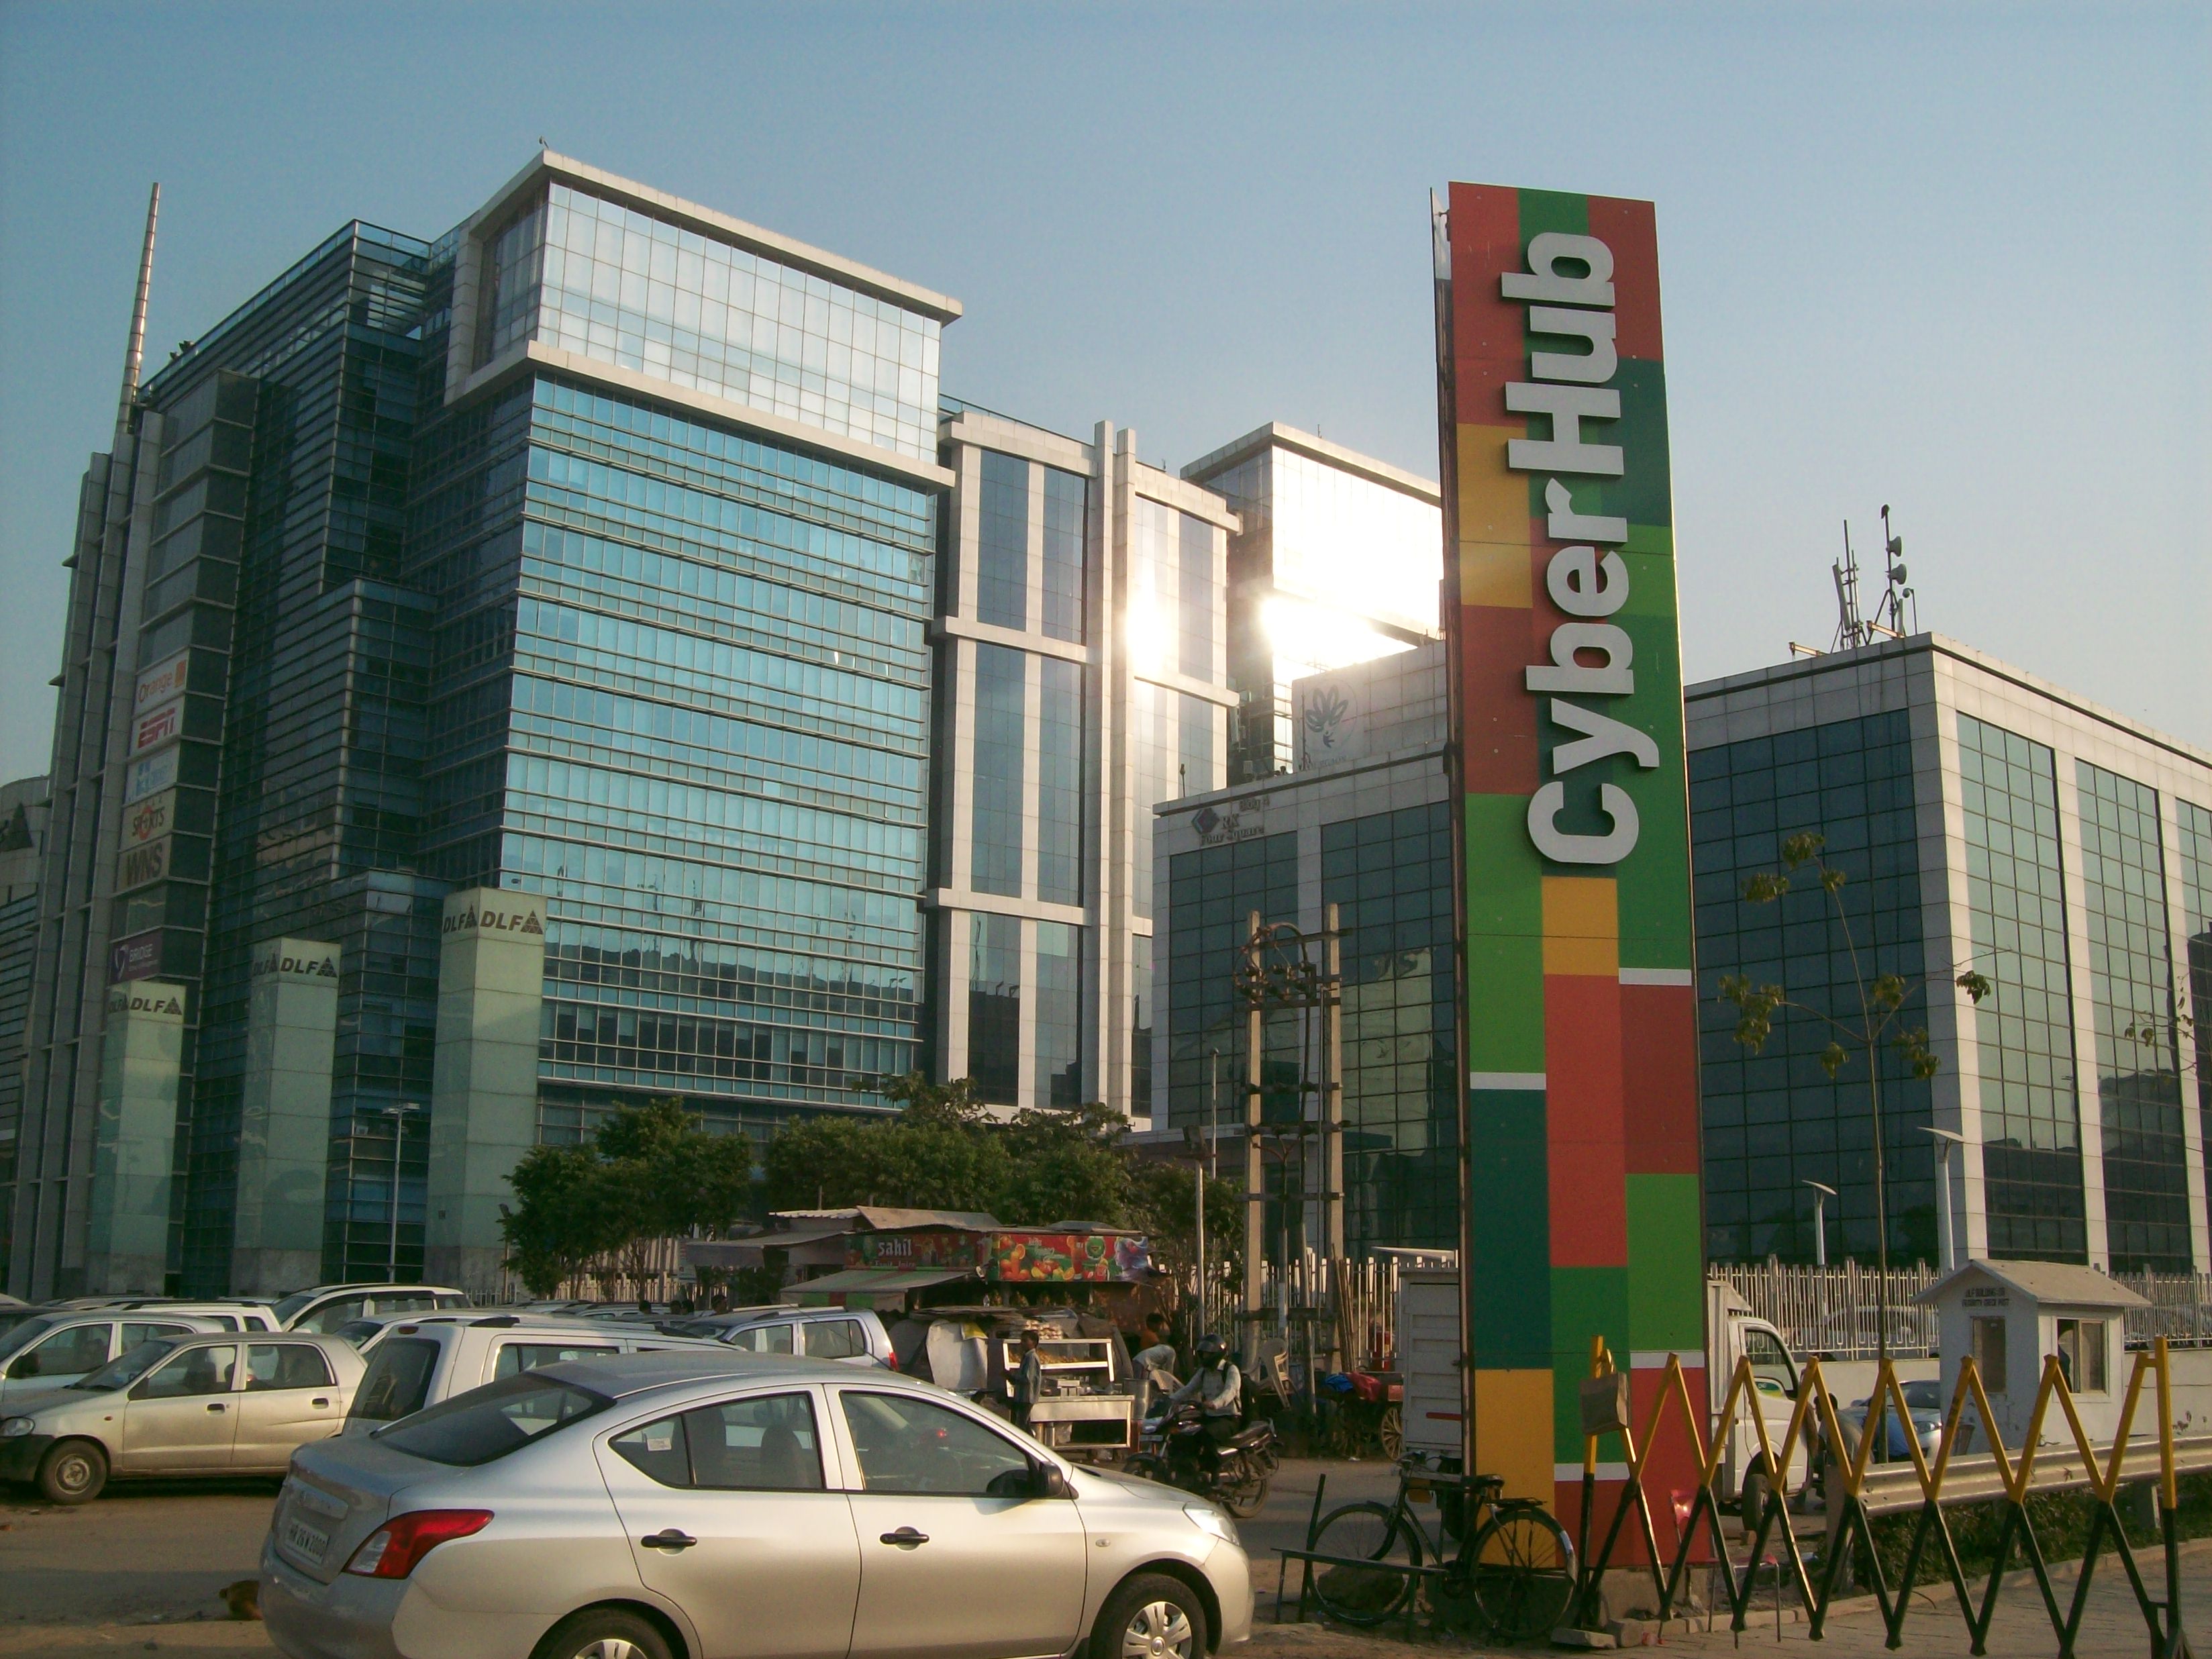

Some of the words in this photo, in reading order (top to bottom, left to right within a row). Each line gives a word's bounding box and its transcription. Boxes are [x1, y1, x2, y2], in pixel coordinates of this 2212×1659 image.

[1501, 232, 1659, 864] CyberHub
[138, 672, 172, 703] Orange
[138, 707, 176, 748] ESPN
[126, 842, 162, 887] WNS
[443, 913, 466, 934] DLF
[479, 910, 523, 931] DLF
[281, 957, 319, 974] DLF
[130, 997, 166, 1013] DLF
[878, 1238, 913, 1256] sahil
